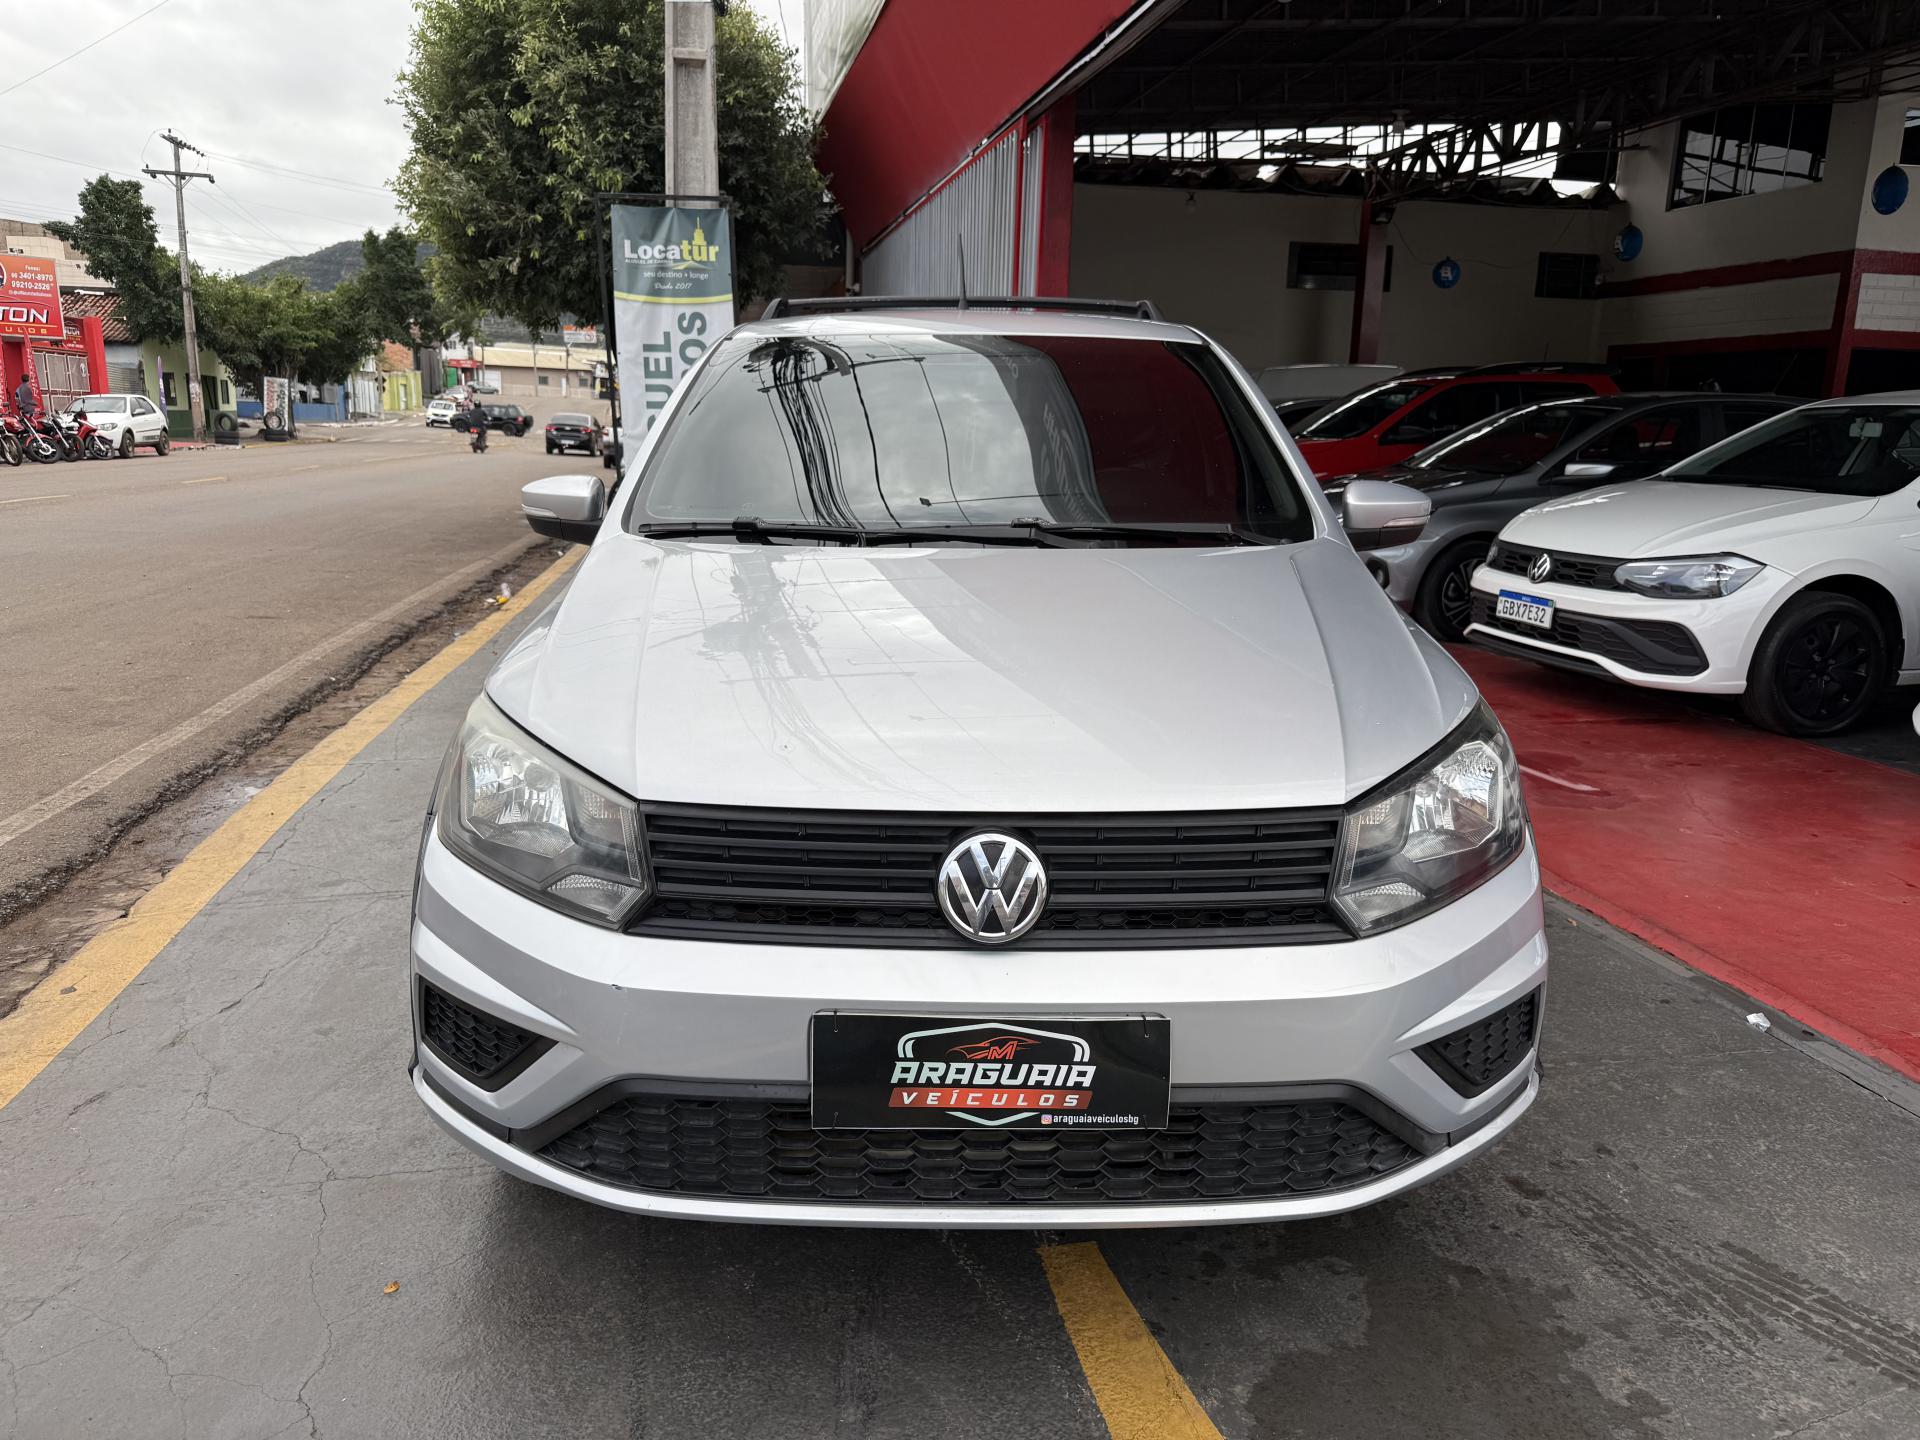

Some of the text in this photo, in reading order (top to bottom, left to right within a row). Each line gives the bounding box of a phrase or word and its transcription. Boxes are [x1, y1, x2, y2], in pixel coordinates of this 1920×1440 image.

[624, 239, 719, 262] Locatur
[657, 270, 682, 278] destino
[689, 271, 709, 280] longe
[1502, 599, 1546, 623] GBX7E32
[890, 1061, 1097, 1087] ARAGUAIA
[901, 1089, 1080, 1107] VEÍCULOS
[1053, 1113, 1139, 1125] araguaiaveiculosbg
